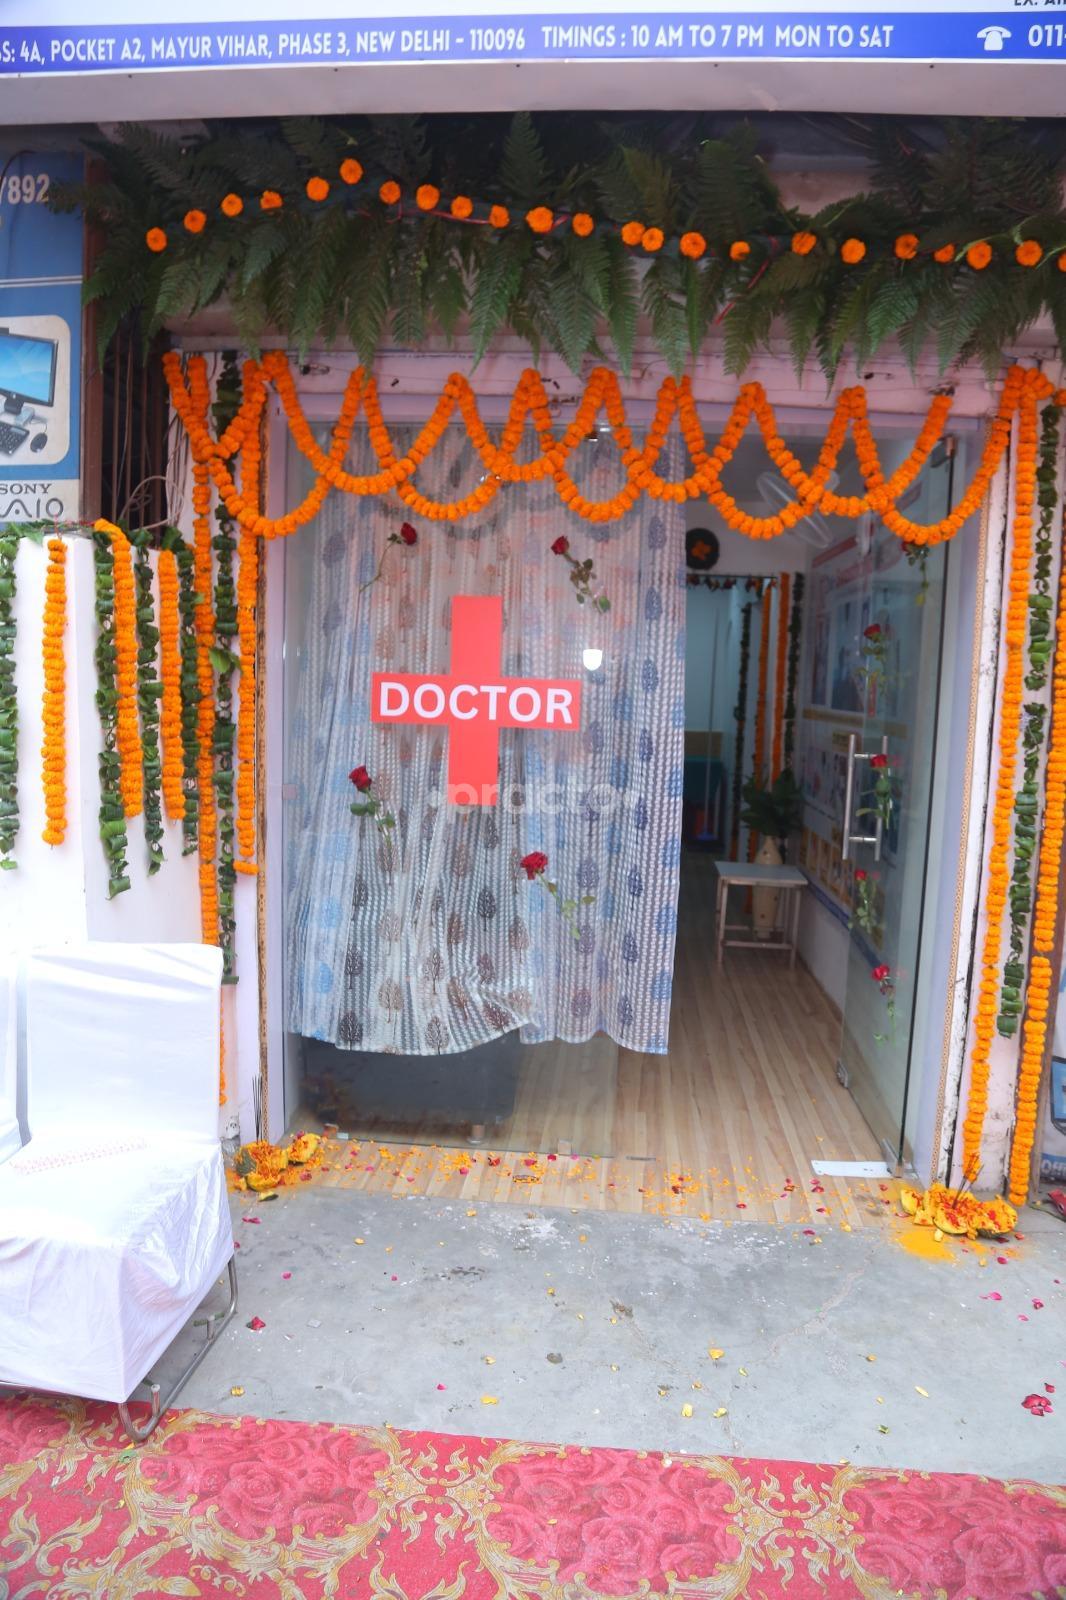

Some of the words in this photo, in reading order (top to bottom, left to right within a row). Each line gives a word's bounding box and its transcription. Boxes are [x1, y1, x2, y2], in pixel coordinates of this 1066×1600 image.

[0, 40, 15, 62] S:
[20, 39, 45, 65] 4A,
[51, 38, 116, 62] POCKET
[120, 38, 146, 63] A2,
[151, 36, 212, 60] MAYUR
[217, 34, 273, 59] VIHAR,
[278, 32, 332, 56] PHASE
[336, 31, 351, 57] 3,
[356, 30, 395, 54] NEW
[401, 29, 450, 52] DELHI
[470, 28, 525, 50] 110096
[542, 25, 615, 48] TIMINGS
[630, 24, 650, 48] 10
[655, 24, 683, 48] AM
[689, 24, 716, 48] TO
[721, 24, 732, 47] 7
[736, 24, 764, 47] PM
[775, 25, 820, 47] MON
[826, 25, 852, 47] TO
[859, 25, 894, 48] SAT
[0, 483, 52, 495] SONY
[379, 681, 573, 724] DOCTOR
